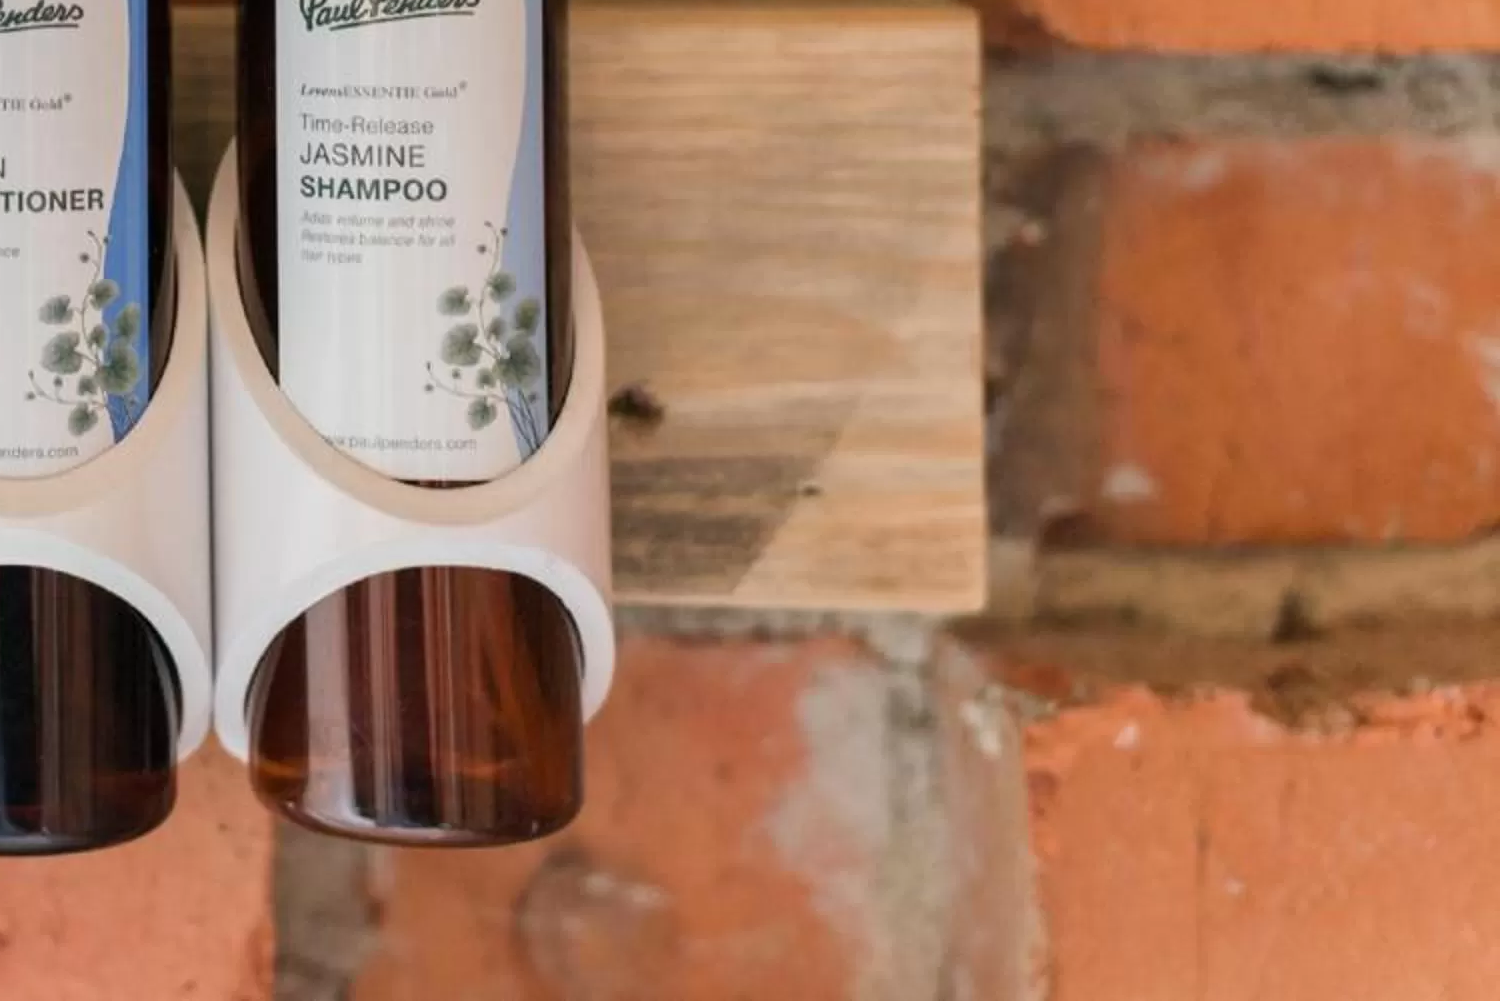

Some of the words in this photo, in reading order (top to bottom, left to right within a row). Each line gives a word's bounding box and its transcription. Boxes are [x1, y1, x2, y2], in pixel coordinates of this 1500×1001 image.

[300, 112, 434, 135] Time-Release
[300, 142, 426, 168] JASMINE
[300, 174, 448, 202] SHAMPOO
